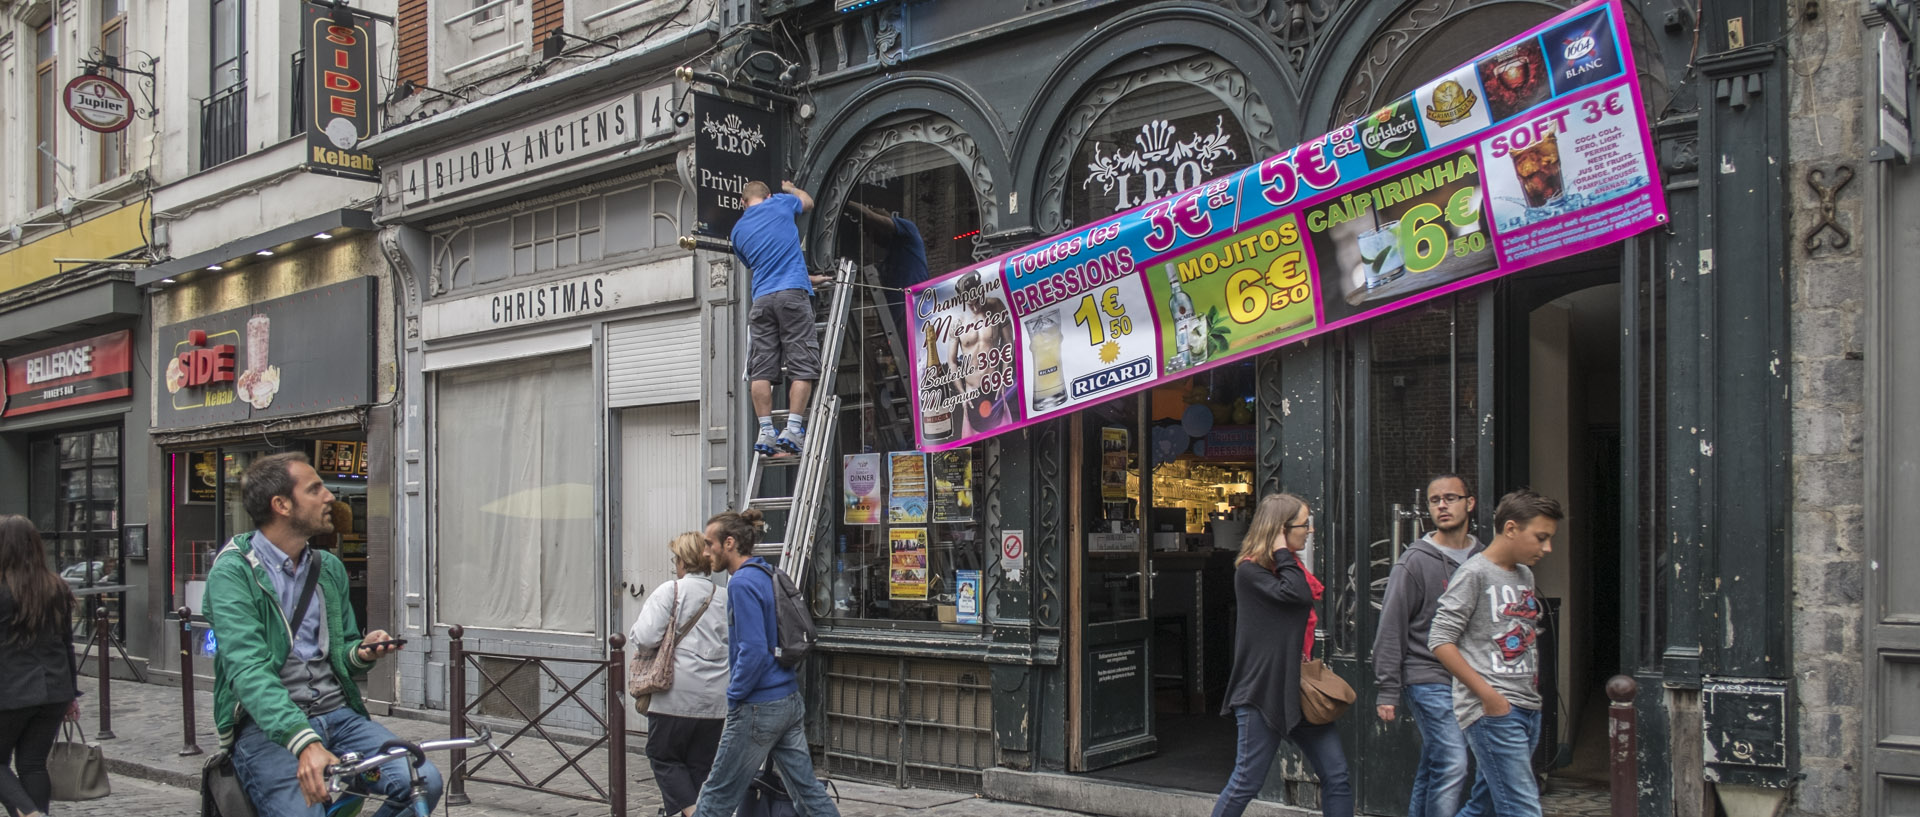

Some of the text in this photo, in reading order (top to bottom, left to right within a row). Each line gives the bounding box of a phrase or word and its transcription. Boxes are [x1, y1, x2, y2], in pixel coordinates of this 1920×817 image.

[1567, 37, 1592, 56] 1664
[325, 25, 361, 117] SIDE
[1566, 58, 1603, 79] BLANC
[78, 94, 122, 111] Jupiler
[1431, 99, 1474, 120] GRIMBERGEN
[1330, 124, 1356, 145] 50
[1362, 114, 1417, 149] Carlsberg
[1491, 92, 1624, 158] SOFT 3€
[1575, 134, 1597, 145] COCA
[314, 146, 374, 171] Kebab
[408, 96, 662, 195] 4 BIJOUX ANCIENS 4
[715, 132, 753, 156] I.P.O
[1333, 140, 1362, 158] CL
[700, 168, 748, 195] Privilè
[1260, 138, 1341, 206] 5€
[1578, 167, 1593, 176] JUS
[1594, 162, 1605, 171] DE
[718, 194, 746, 210] LE BA
[1207, 179, 1230, 197] 25
[1209, 193, 1234, 210] CL
[1307, 154, 1478, 233] CAÏPIRINHA
[1087, 222, 1121, 249] les
[1141, 186, 1213, 252] 3€
[1399, 186, 1486, 273] 6€ 50
[1011, 236, 1082, 278] Toutes
[1177, 222, 1299, 284] MOJITOS
[917, 277, 1001, 319] Champagne
[1012, 246, 1136, 316] PRESSIONS
[1225, 251, 1311, 325] 6€ 50
[492, 278, 603, 323] CHRISTMAS
[1074, 286, 1132, 346] 1€ 50
[920, 309, 1010, 349] Mercier
[27, 345, 94, 384] BELLEROSE
[177, 344, 236, 389] SIDE
[920, 344, 1013, 390] Bouteille 39€
[1075, 362, 1148, 395] RICARD
[64, 385, 75, 395] BAR
[205, 390, 233, 407] Kebab
[921, 367, 1014, 414] Magnum 69€
[850, 474, 874, 482] DINNER
